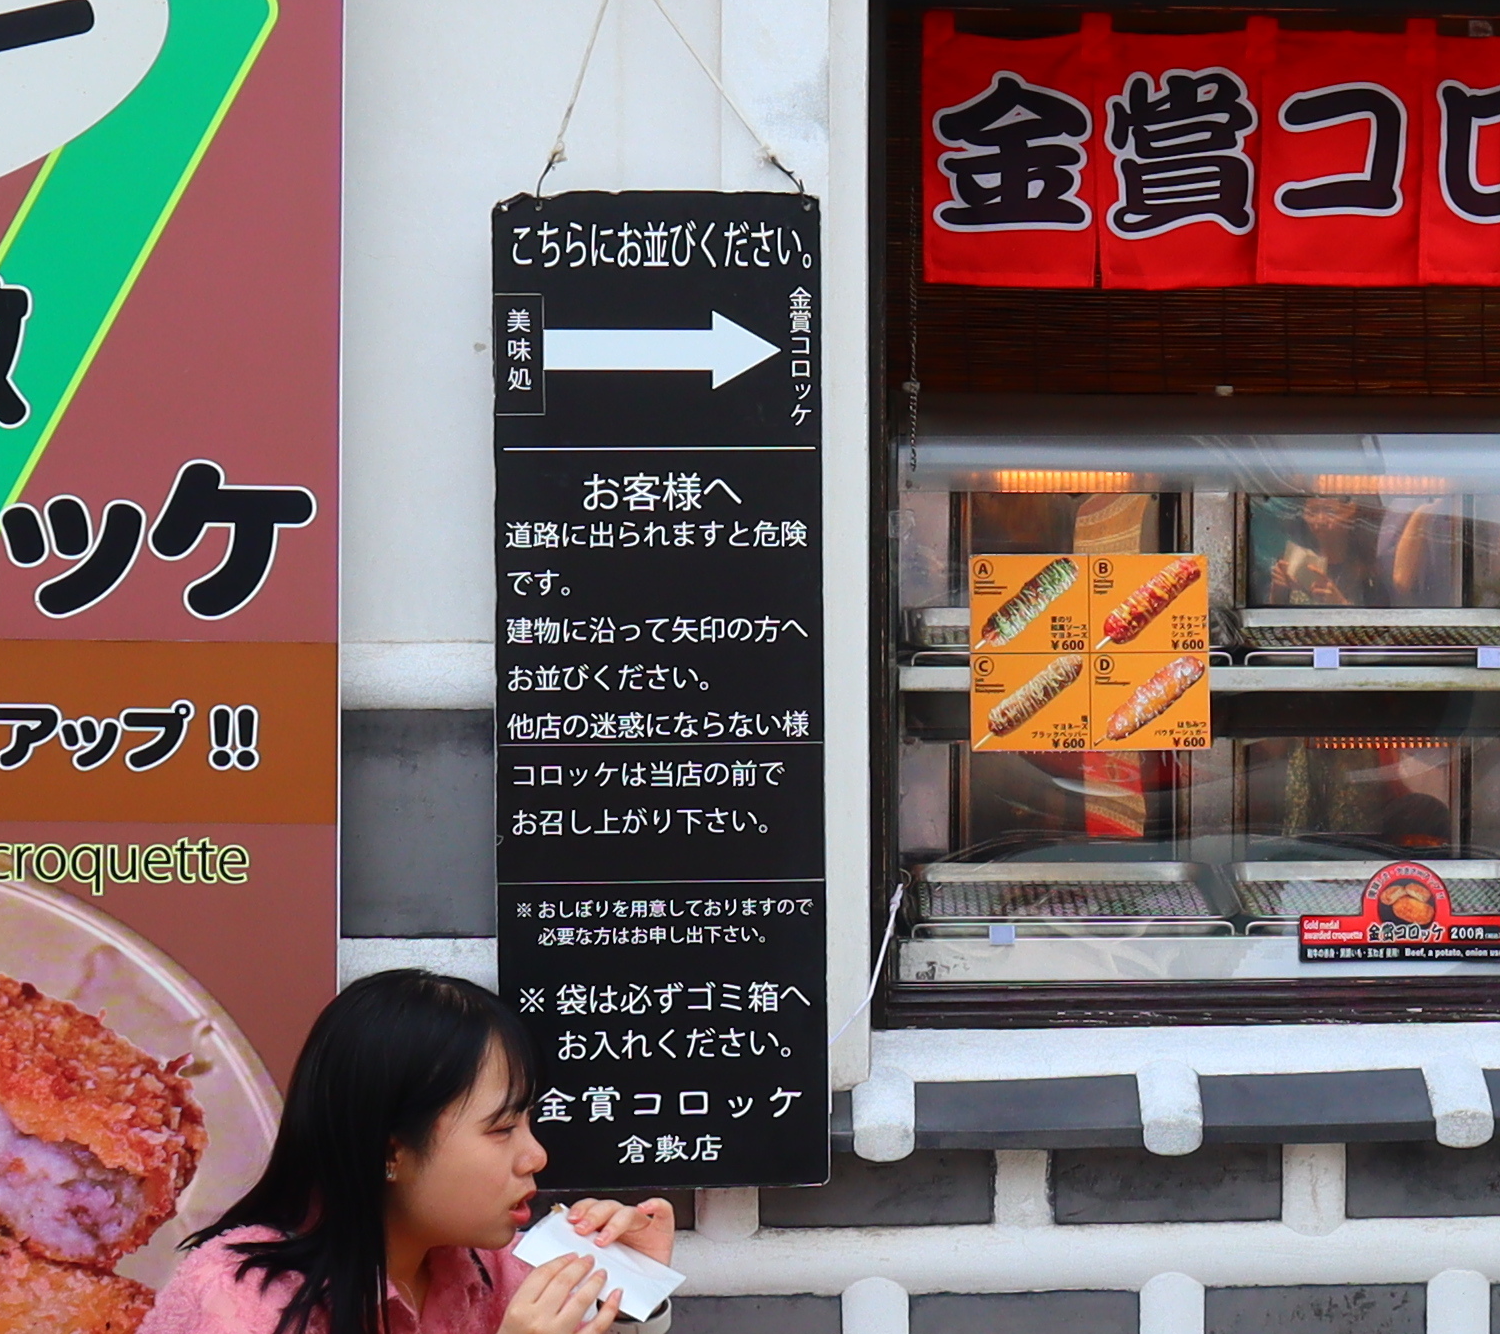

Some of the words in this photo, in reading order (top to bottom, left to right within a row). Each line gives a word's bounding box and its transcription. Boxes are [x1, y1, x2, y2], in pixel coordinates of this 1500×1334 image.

[509, 219, 814, 271] こちらにお並びください。
[506, 308, 533, 392] 美味処
[788, 285, 814, 427] 金賞コロッケ
[581, 471, 743, 513] お客様へ
[504, 519, 809, 550] 道路に出られますと危険
[506, 569, 573, 598] です。
[505, 615, 810, 646] 建物に沿って矢印の方へ
[506, 663, 712, 693] お並びください。
[506, 709, 811, 741] 他店の迷惑にならない様
[511, 759, 787, 789] コロッケは当店の前で
[511, 807, 770, 837] お召し上がり下さい。
[536, 924, 768, 947] 必要な方はお申し出下さい。
[1366, 922, 1445, 943] 金賞コロッケ
[556, 1028, 795, 1062] お入れください。
[536, 1085, 804, 1124] 金賞コロッケ
[616, 1134, 724, 1165] 倉敷店
